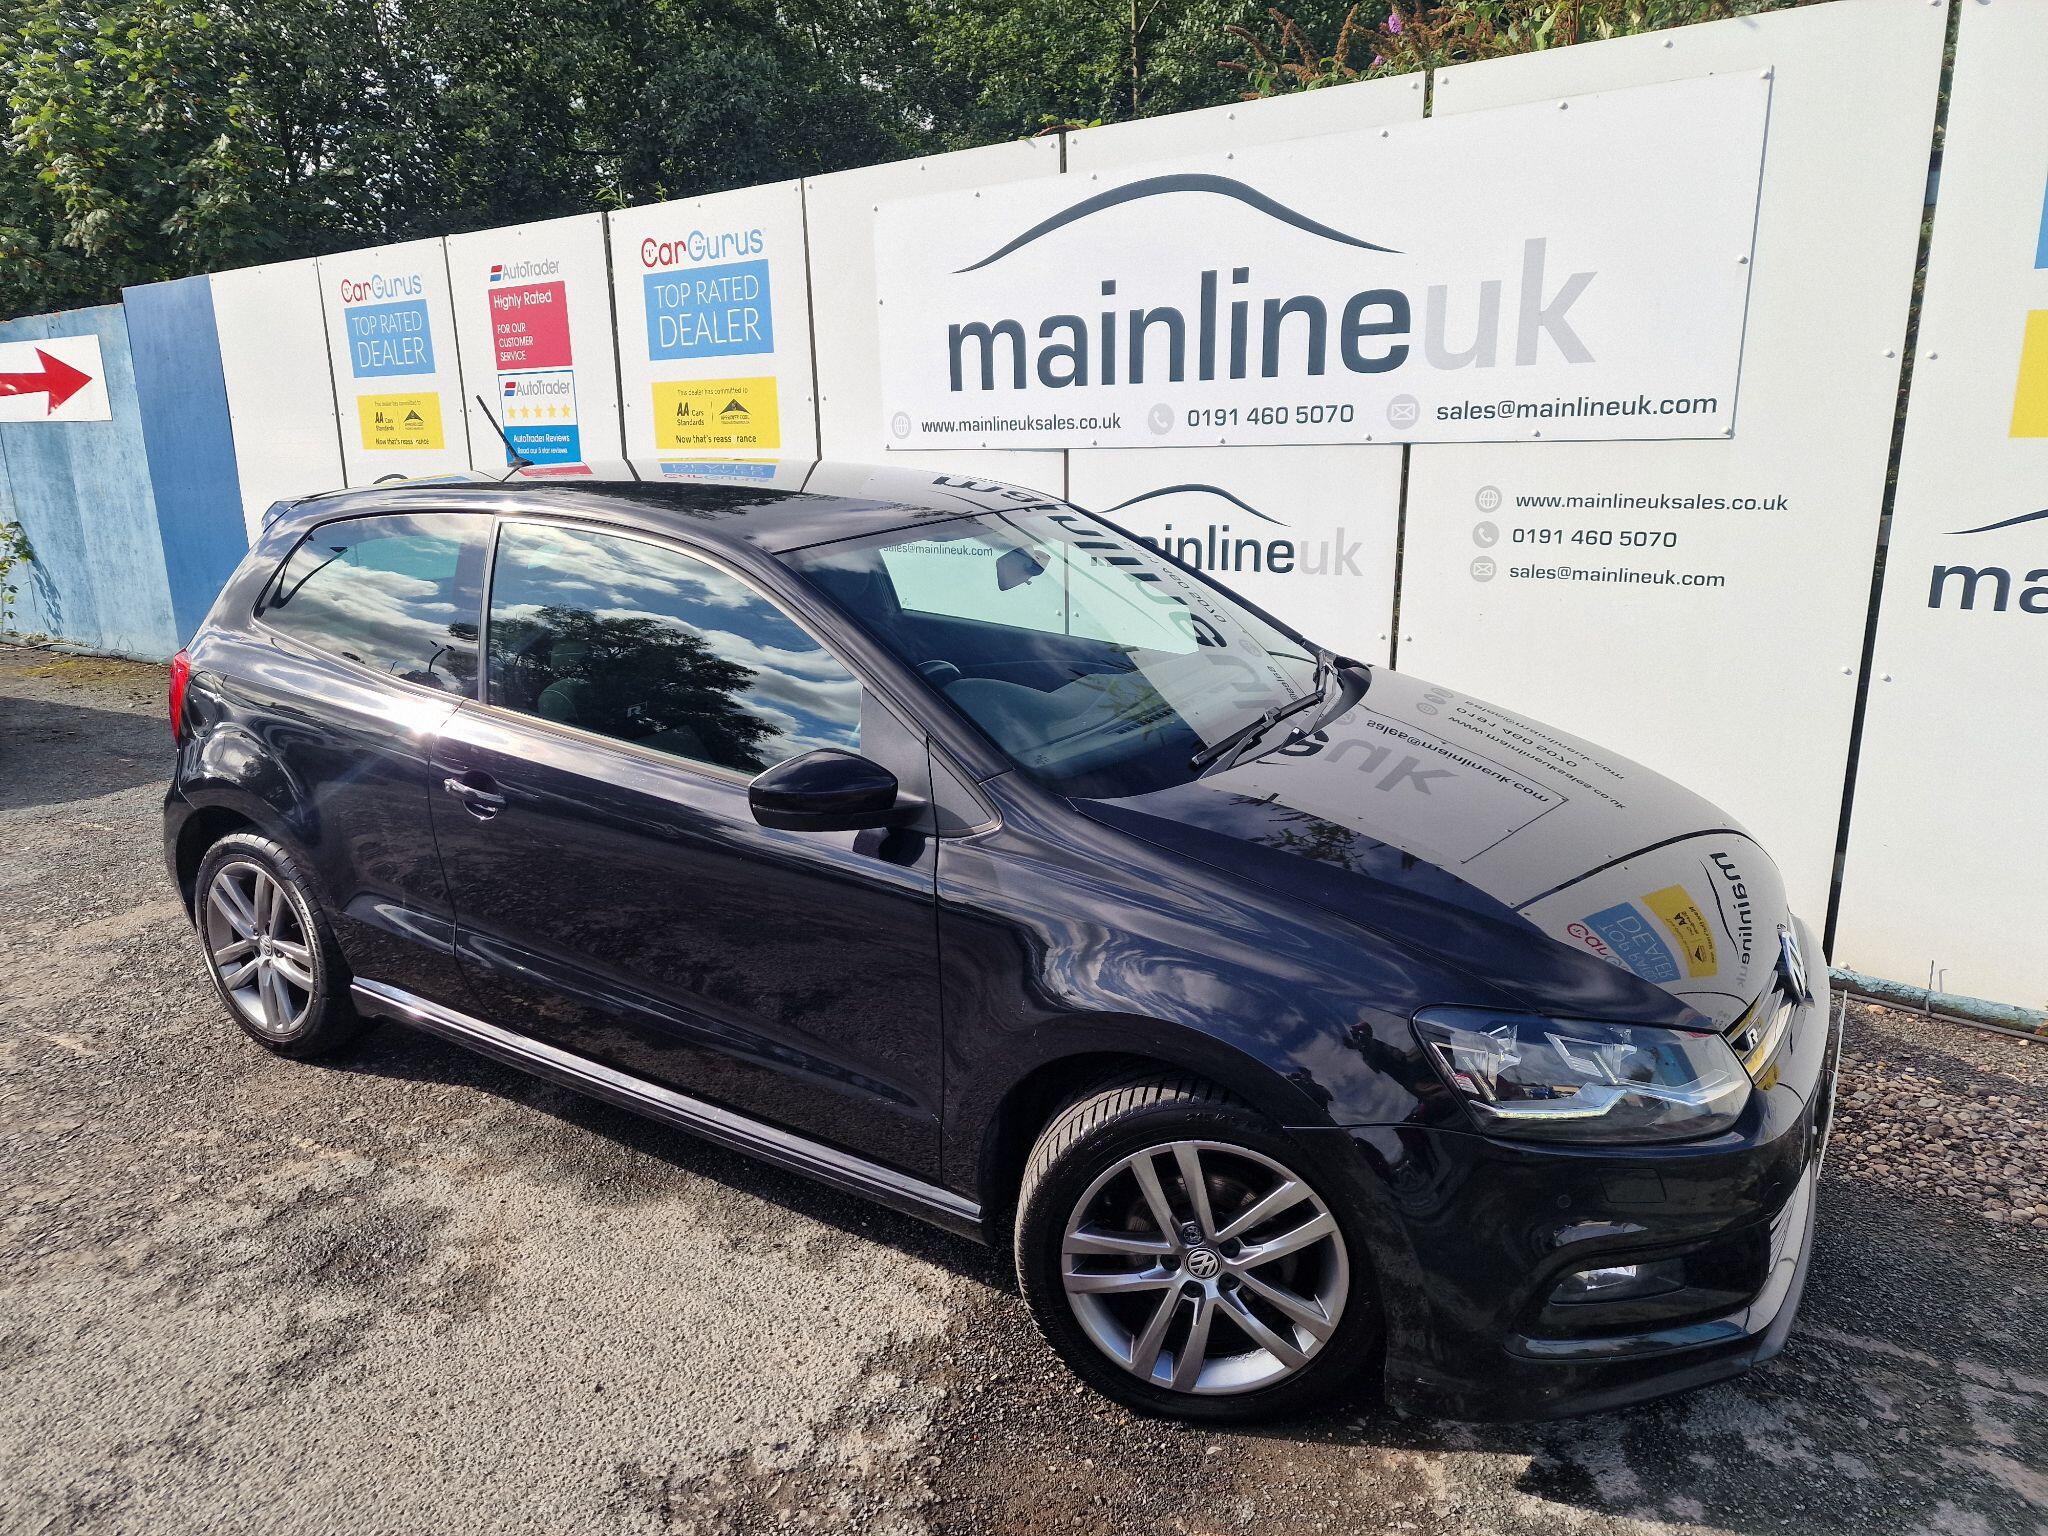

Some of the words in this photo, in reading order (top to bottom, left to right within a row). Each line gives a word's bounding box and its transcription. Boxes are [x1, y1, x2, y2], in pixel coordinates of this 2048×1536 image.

[641, 229, 764, 268] CarGurus
[503, 258, 560, 280] AutoTrader
[341, 274, 422, 303] CarGurus
[654, 282, 691, 309] TOP
[696, 275, 759, 304] RATED
[493, 293, 521, 311] Highly
[523, 289, 552, 305] Rated
[351, 315, 377, 336] TOP
[379, 310, 422, 334] RATED
[948, 237, 1598, 392] mainlineuk
[497, 324, 511, 334] FOR
[511, 322, 526, 333] OUR
[659, 307, 762, 348] DEALER
[357, 336, 427, 368] DEALER
[498, 336, 534, 348] CUSTOMER
[500, 350, 527, 362] SERVICE
[516, 379, 570, 396] AutoTrader
[374, 411, 384, 424] AA
[677, 402, 689, 417] AA
[1187, 407, 1238, 427] 0191
[1246, 406, 1289, 425] 460
[1296, 403, 1354, 424] 5070
[1436, 395, 1718, 420] sales@mainlineuk.com
[676, 418, 705, 426] Standards
[921, 412, 1122, 433] www.mainlineuksales.co.uk
[676, 435, 691, 443] Now
[692, 435, 712, 443] that's
[1515, 493, 1789, 511] www.mainlineuksales.co.uk
[1512, 528, 1563, 544] 0191
[1571, 529, 1612, 546] 460
[1619, 531, 1677, 548] 5070
[1509, 564, 1726, 587] sales@mainlineuk.com
